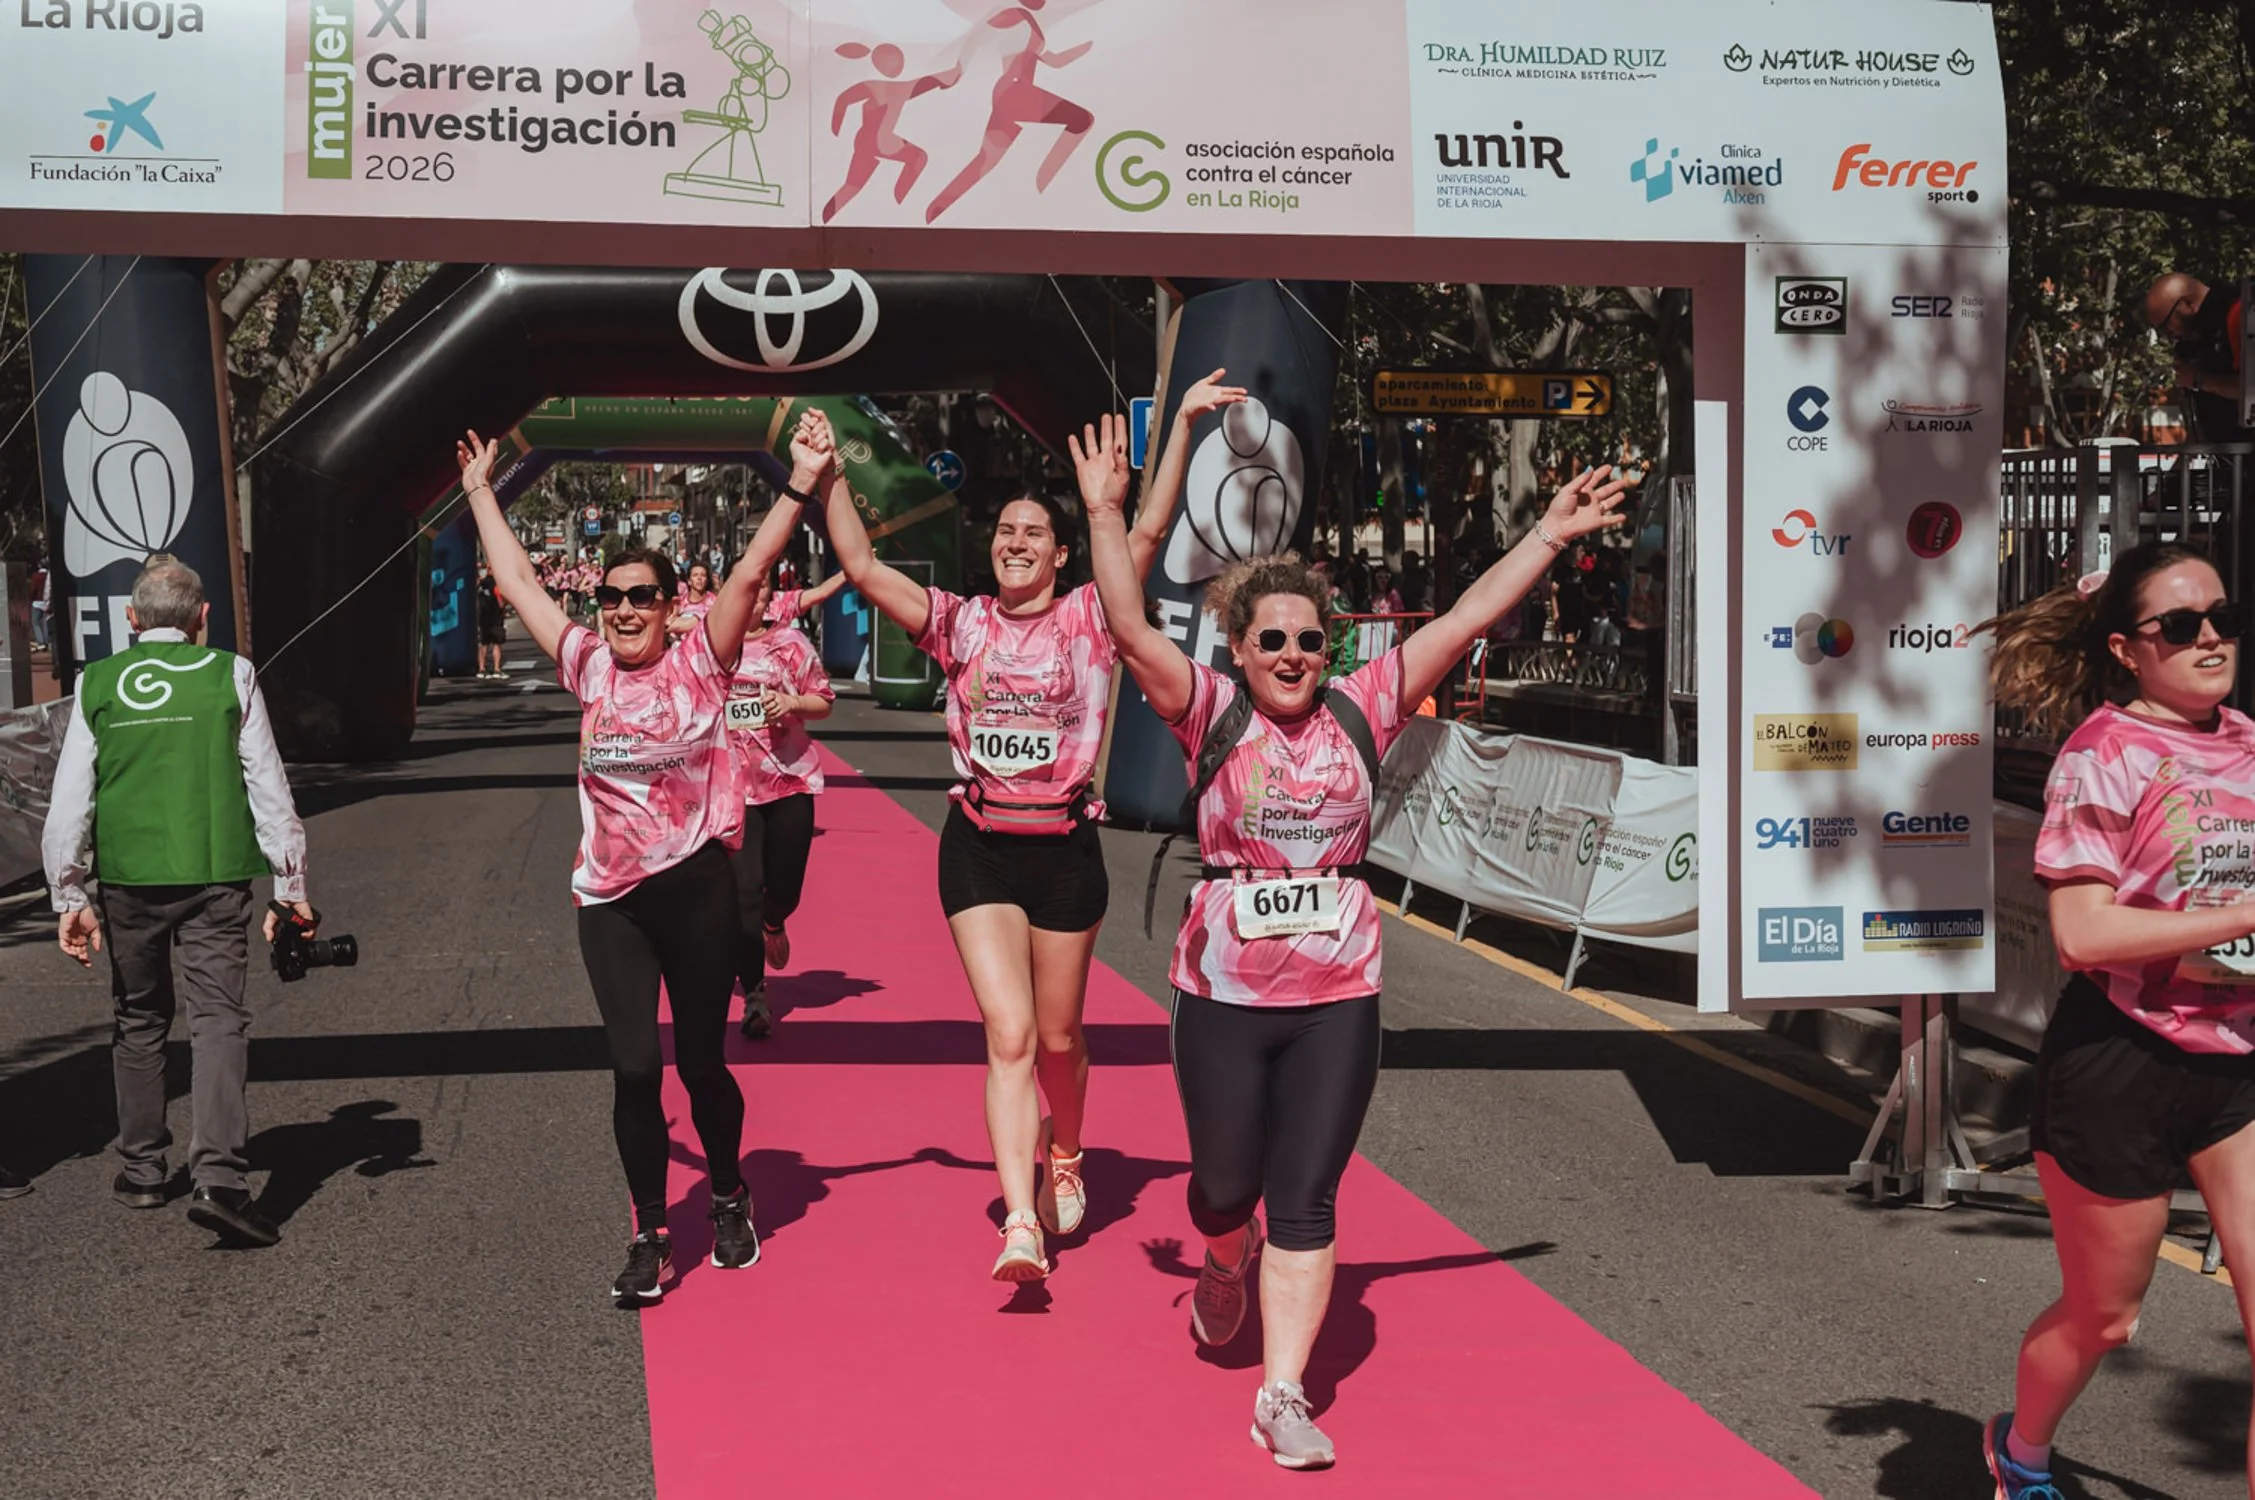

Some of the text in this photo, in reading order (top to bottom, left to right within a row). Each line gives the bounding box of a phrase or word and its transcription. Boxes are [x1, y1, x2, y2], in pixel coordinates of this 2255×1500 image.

[20, 0, 204, 40] La Rioja
[366, 0, 427, 39] XI
[1480, 41, 1607, 66] HUMILDAD
[1613, 49, 1667, 70] RUIZ
[1759, 48, 1940, 73] NATUR HOUSE
[304, 5, 358, 159] mujer
[366, 53, 686, 103] Carrera por la
[1516, 69, 1577, 80] MEDICINA
[1581, 70, 1636, 81] ESTÉTICA
[1762, 75, 1941, 88] Expertos en Nutrición y Dietética
[366, 102, 676, 152] investigación
[1185, 140, 1395, 165] asociación española
[30, 162, 131, 182] Fundación
[365, 151, 455, 182] 2026
[1185, 165, 1353, 185] contra el cáncer
[1679, 157, 1783, 186] viamed
[1436, 174, 1511, 184] UNIVERSIDAD
[1436, 186, 1527, 197] INTERNACIONAL
[1927, 190, 1964, 203] sport
[1186, 190, 1300, 213] en La Rioja
[1437, 198, 1503, 209] DE LA RIOJA
[1786, 290, 1835, 302] ONDA
[1789, 309, 1834, 322] CERO
[1428, 394, 1536, 410] Ayuntamiento
[1549, 382, 1568, 406] P
[1907, 420, 1927, 432] LA
[1929, 420, 1973, 432] RIOJA
[1787, 436, 1828, 451] COPE
[1809, 530, 1852, 556] tvr
[1889, 623, 1969, 654] rioja2
[984, 688, 1042, 703] Carrera
[593, 731, 642, 744] Carrera
[1765, 721, 1828, 740] BALCÓN
[974, 732, 1051, 761] 10645
[1808, 739, 1852, 755] MATEO
[1865, 732, 1980, 751] europa press
[589, 745, 628, 759] por la
[590, 756, 686, 775] investigación
[1268, 766, 1284, 780] XI
[2189, 788, 2214, 809] XI
[1262, 807, 1290, 821] por
[1813, 816, 1855, 827] nueve
[1882, 811, 1970, 834] Gente
[1755, 817, 1811, 849] 941
[1813, 826, 1858, 838] cuatro
[1813, 837, 1840, 849] uno
[2200, 839, 2251, 867] por la
[1603, 855, 1625, 873] Rioja
[1253, 883, 1320, 917] 6671
[1765, 915, 1838, 945] El Día
[1899, 918, 1982, 937] RADIO LOGROÑO
[1792, 942, 1839, 955] de La Rioja
